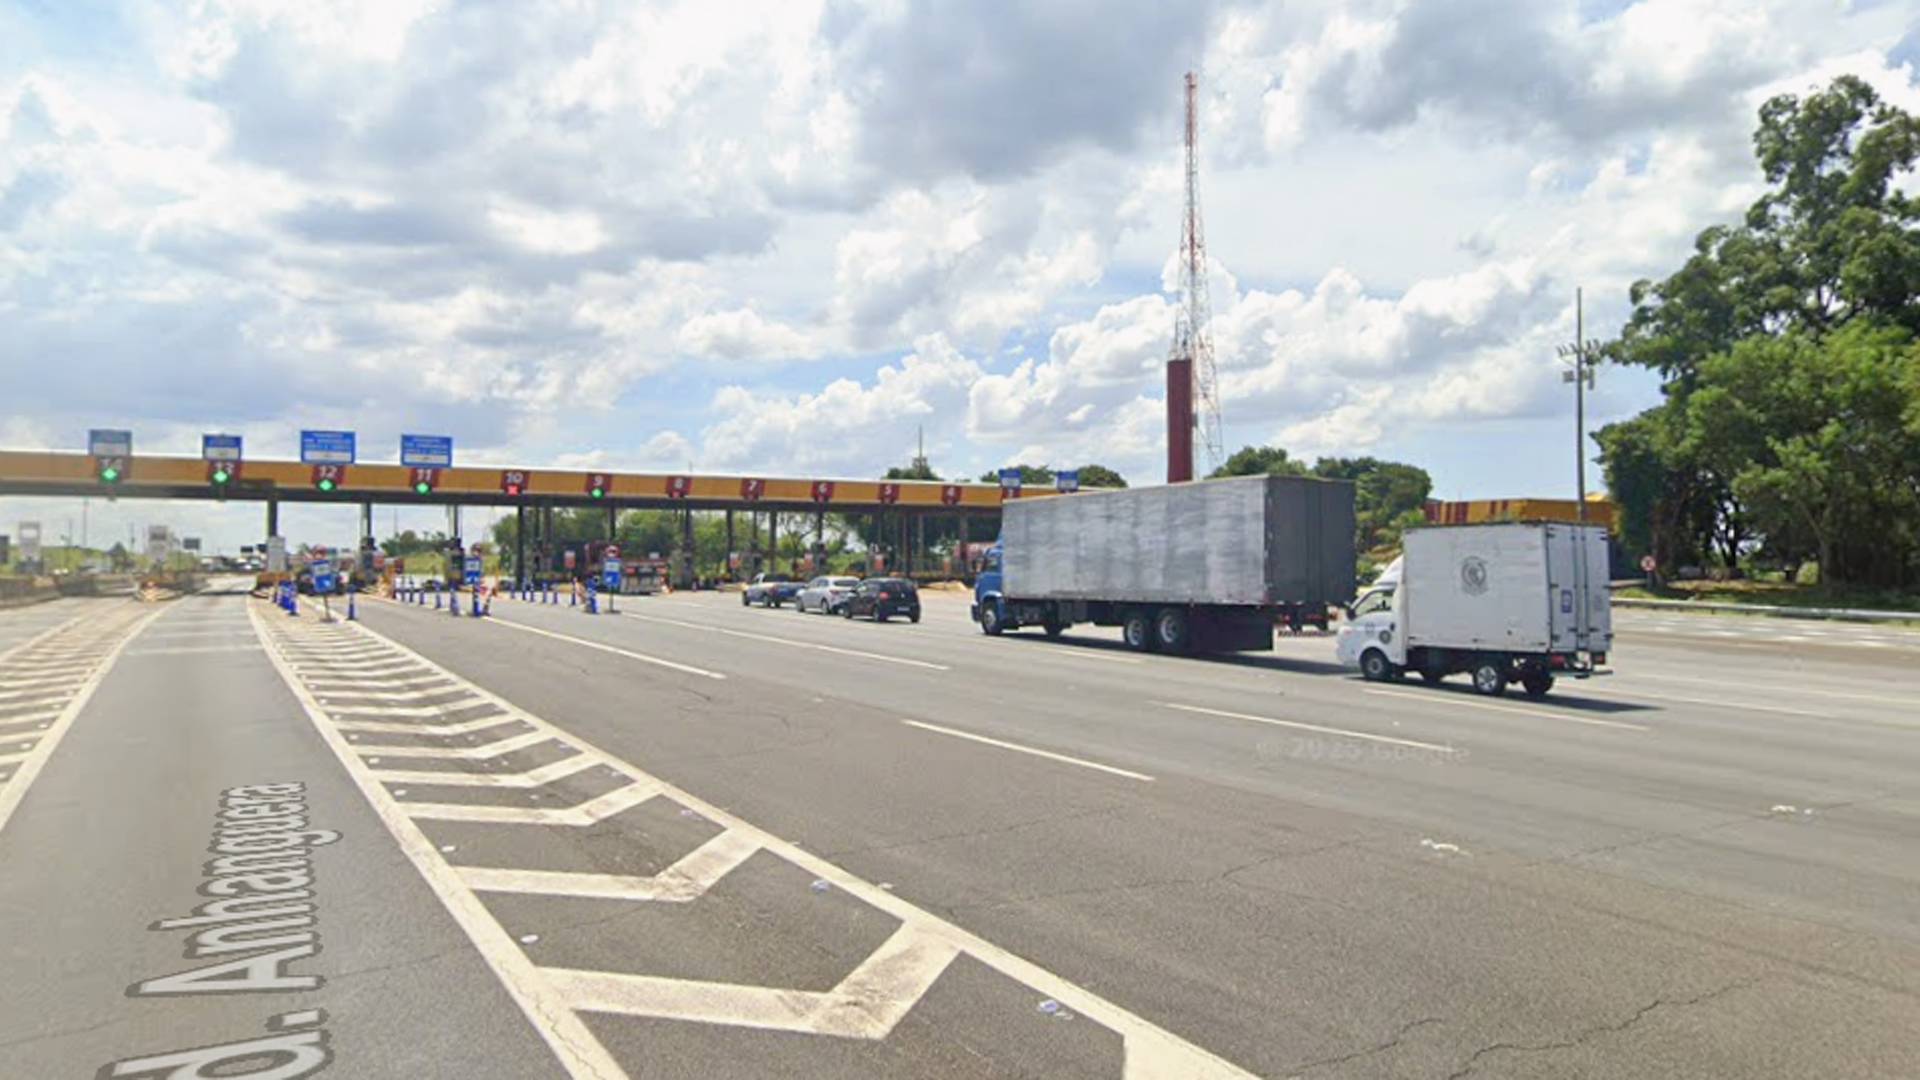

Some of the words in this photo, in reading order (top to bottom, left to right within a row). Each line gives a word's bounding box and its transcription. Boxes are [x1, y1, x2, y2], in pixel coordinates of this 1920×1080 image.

[318, 465, 337, 477] 12
[416, 468, 433, 481] 11
[505, 472, 523, 484] 10
[593, 475, 604, 487] 9
[748, 480, 757, 491] 7
[818, 483, 828, 494] 6
[883, 484, 893, 496] 5
